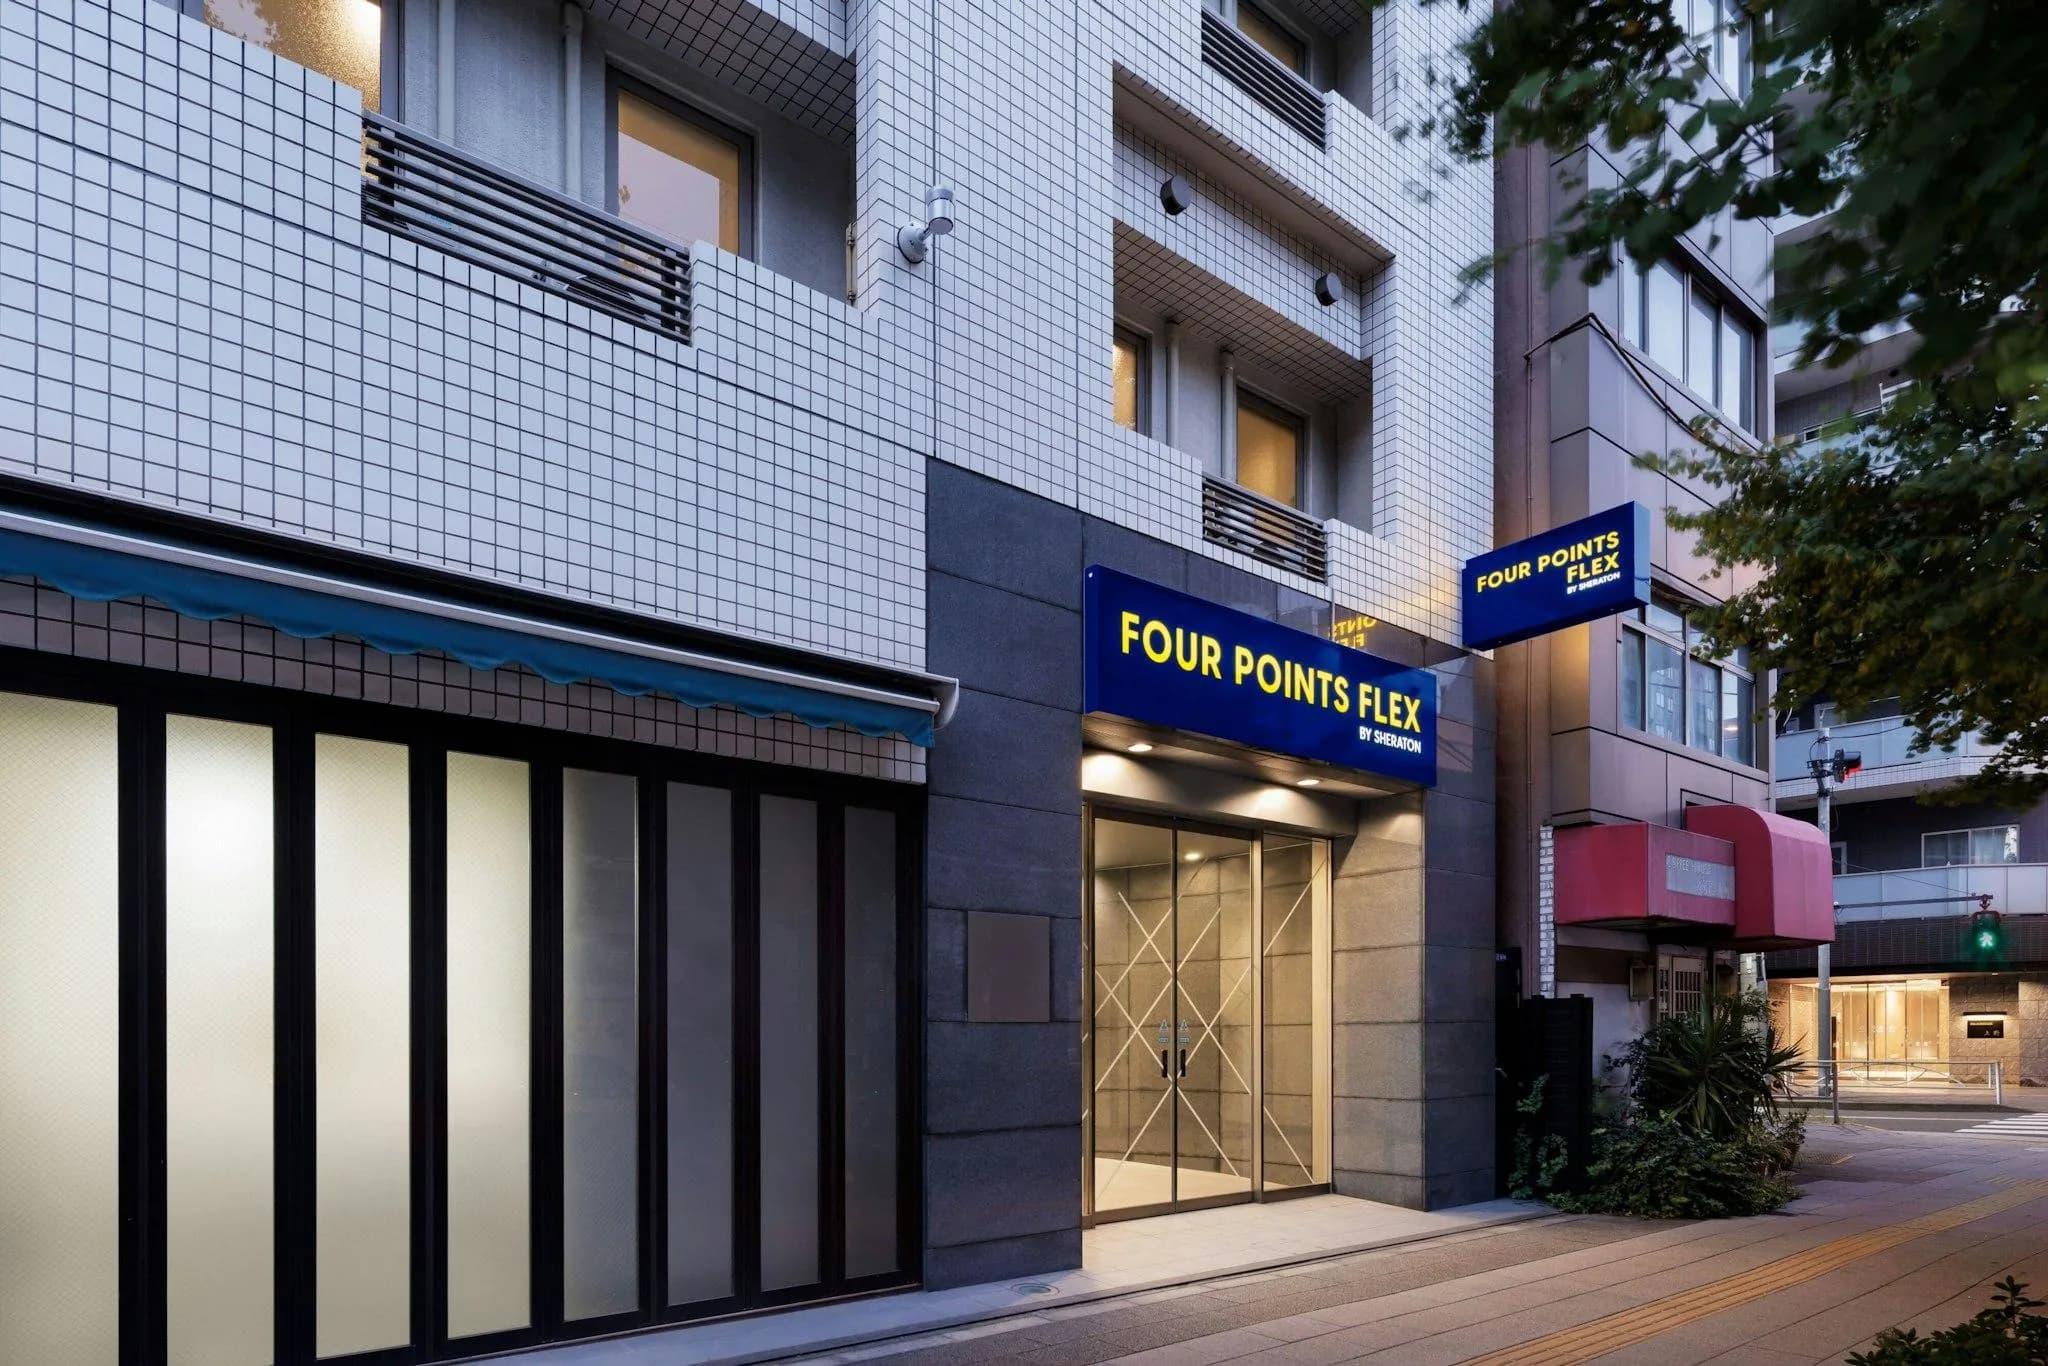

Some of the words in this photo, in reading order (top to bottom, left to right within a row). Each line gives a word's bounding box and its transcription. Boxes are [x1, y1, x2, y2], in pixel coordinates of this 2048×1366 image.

[1477, 562, 1531, 593] FOUR
[1538, 531, 1620, 573] POINTS
[1566, 551, 1620, 584] FLEX
[1566, 584, 1578, 595] BY
[1578, 571, 1621, 591] SHERATON
[1121, 611, 1223, 681] FOUR
[1234, 645, 1350, 713] POINTS
[1359, 682, 1421, 733] FLEX
[1359, 725, 1373, 742] BY
[1373, 729, 1422, 754] SHERATON
